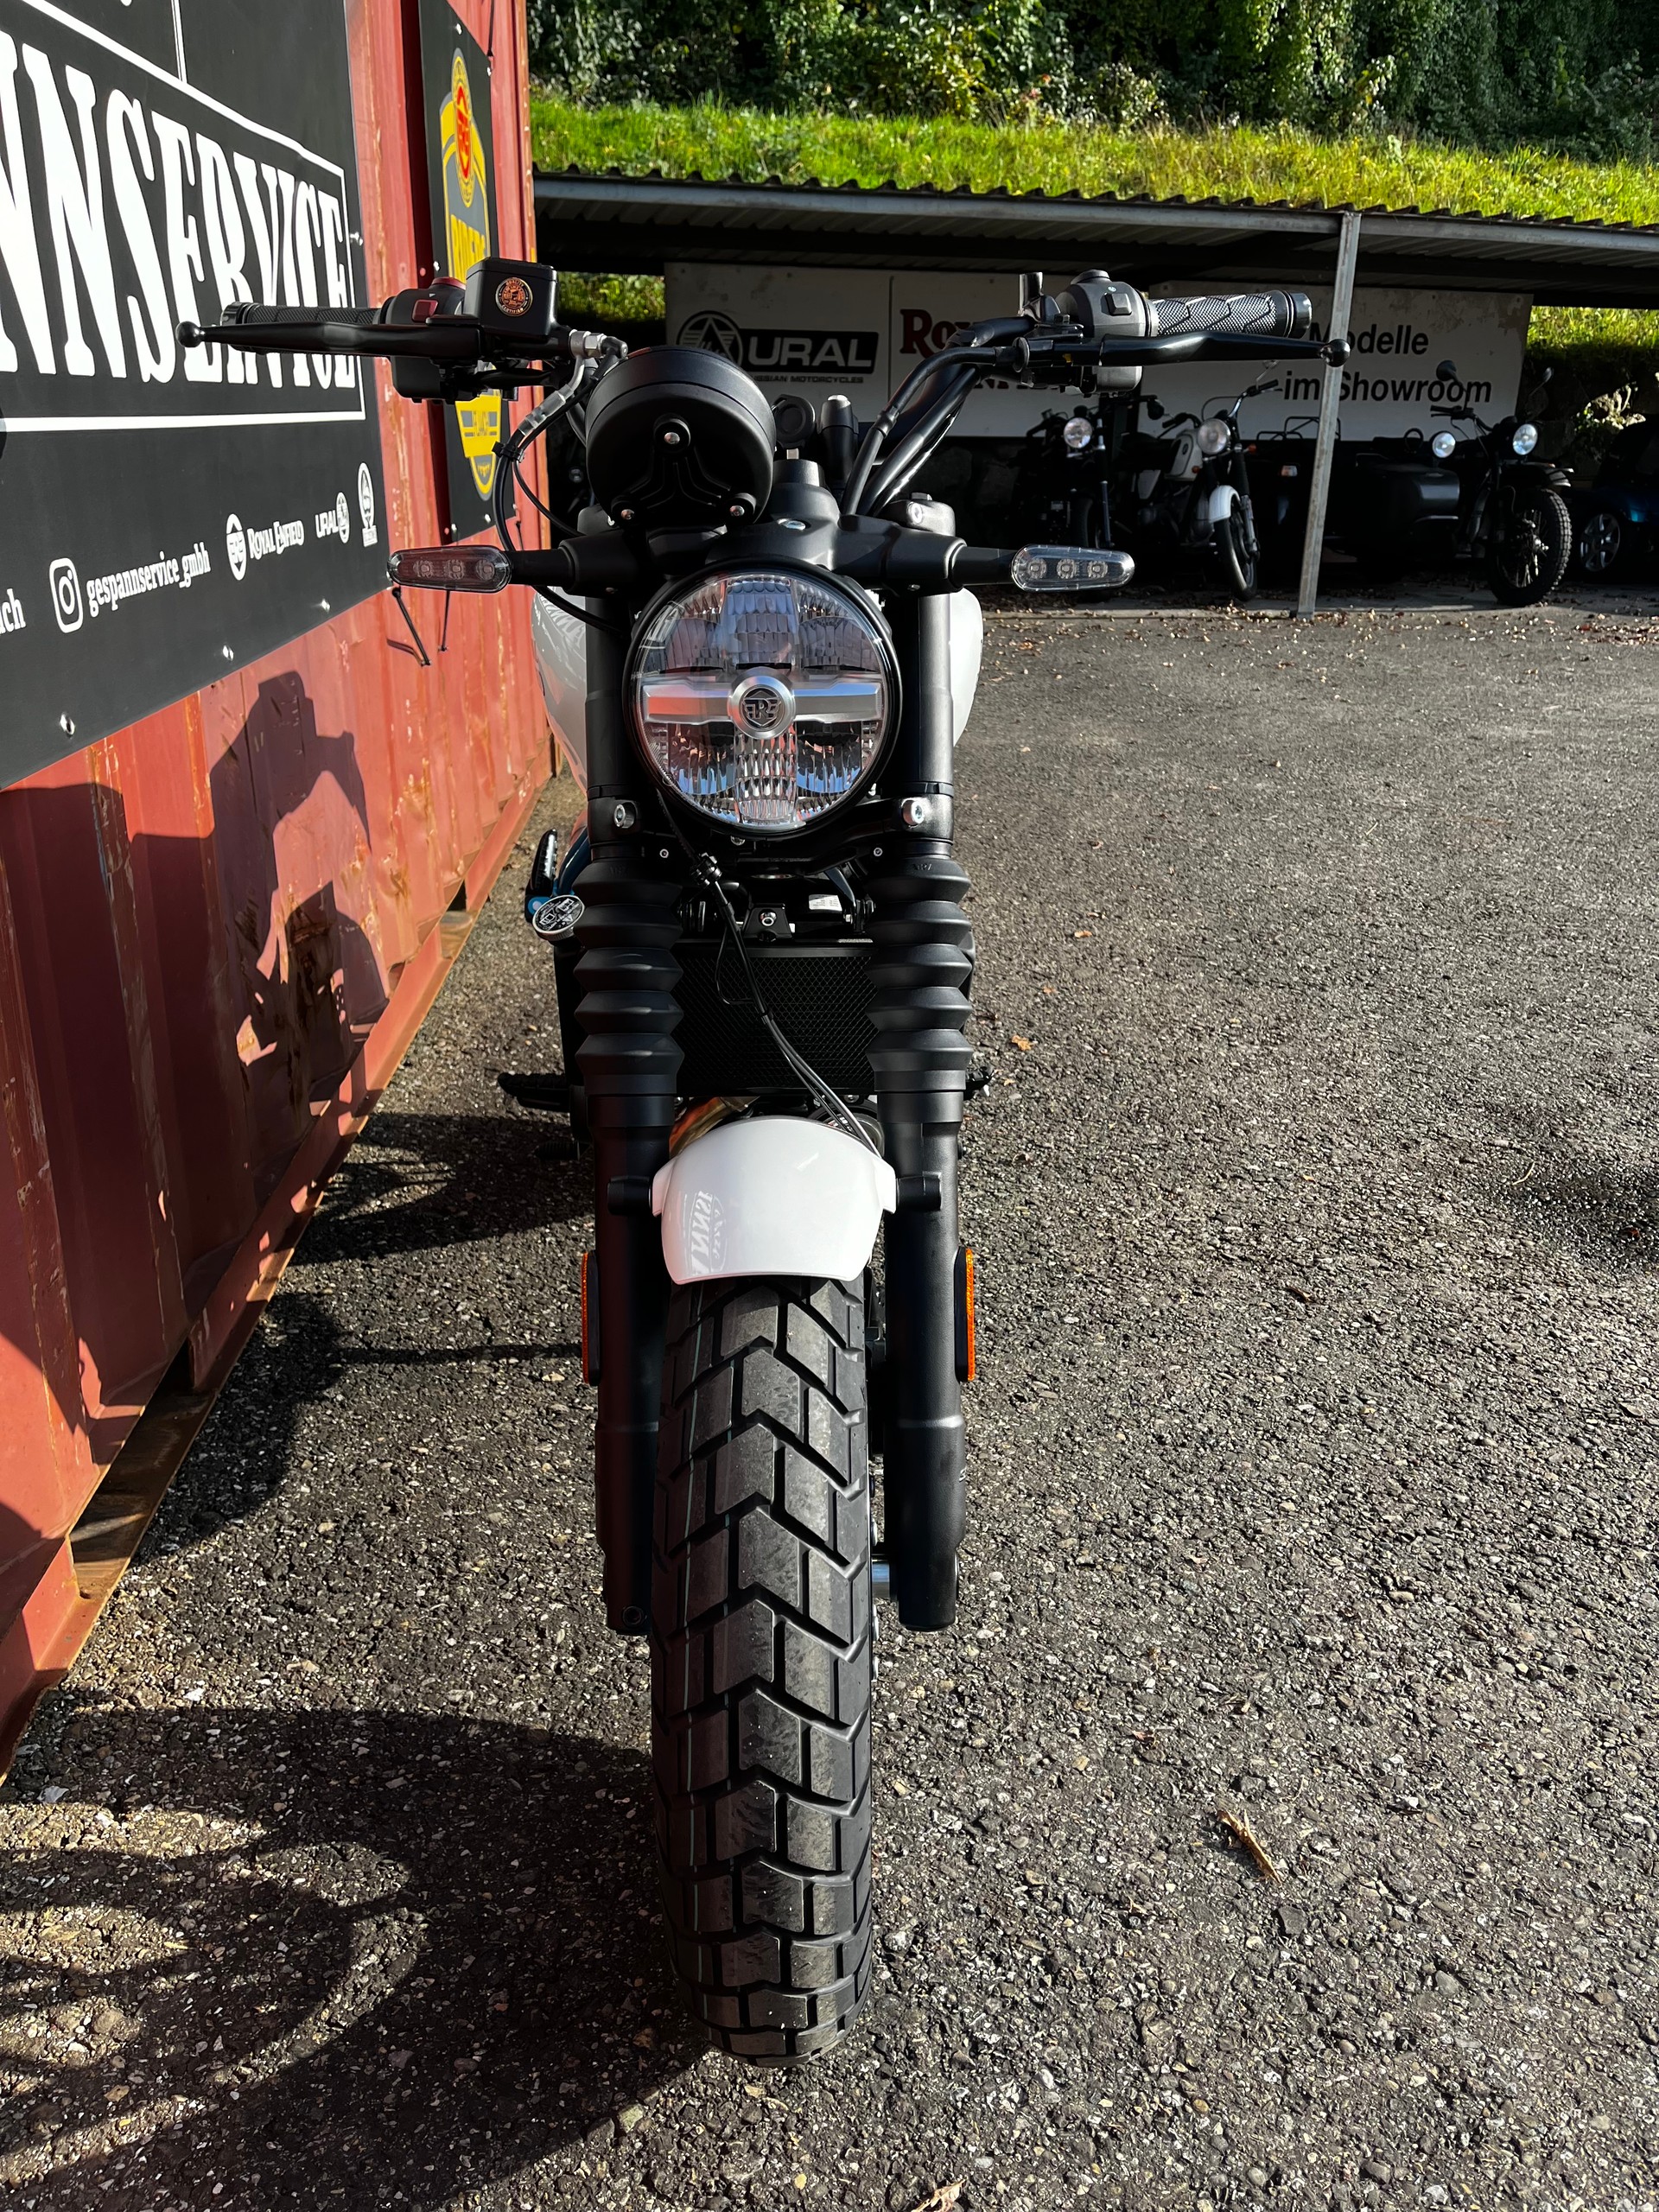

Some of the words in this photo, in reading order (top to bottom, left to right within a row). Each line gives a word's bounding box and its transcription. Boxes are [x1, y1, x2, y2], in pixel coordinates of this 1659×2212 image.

[747, 336, 872, 367] URAL
[790, 375, 865, 384] MOTORCYCLES
[1284, 371, 1319, 400] im
[1339, 371, 1492, 403] Showroom
[315, 509, 340, 538] URAL
[86, 541, 212, 618] gespannservice_gmbh
